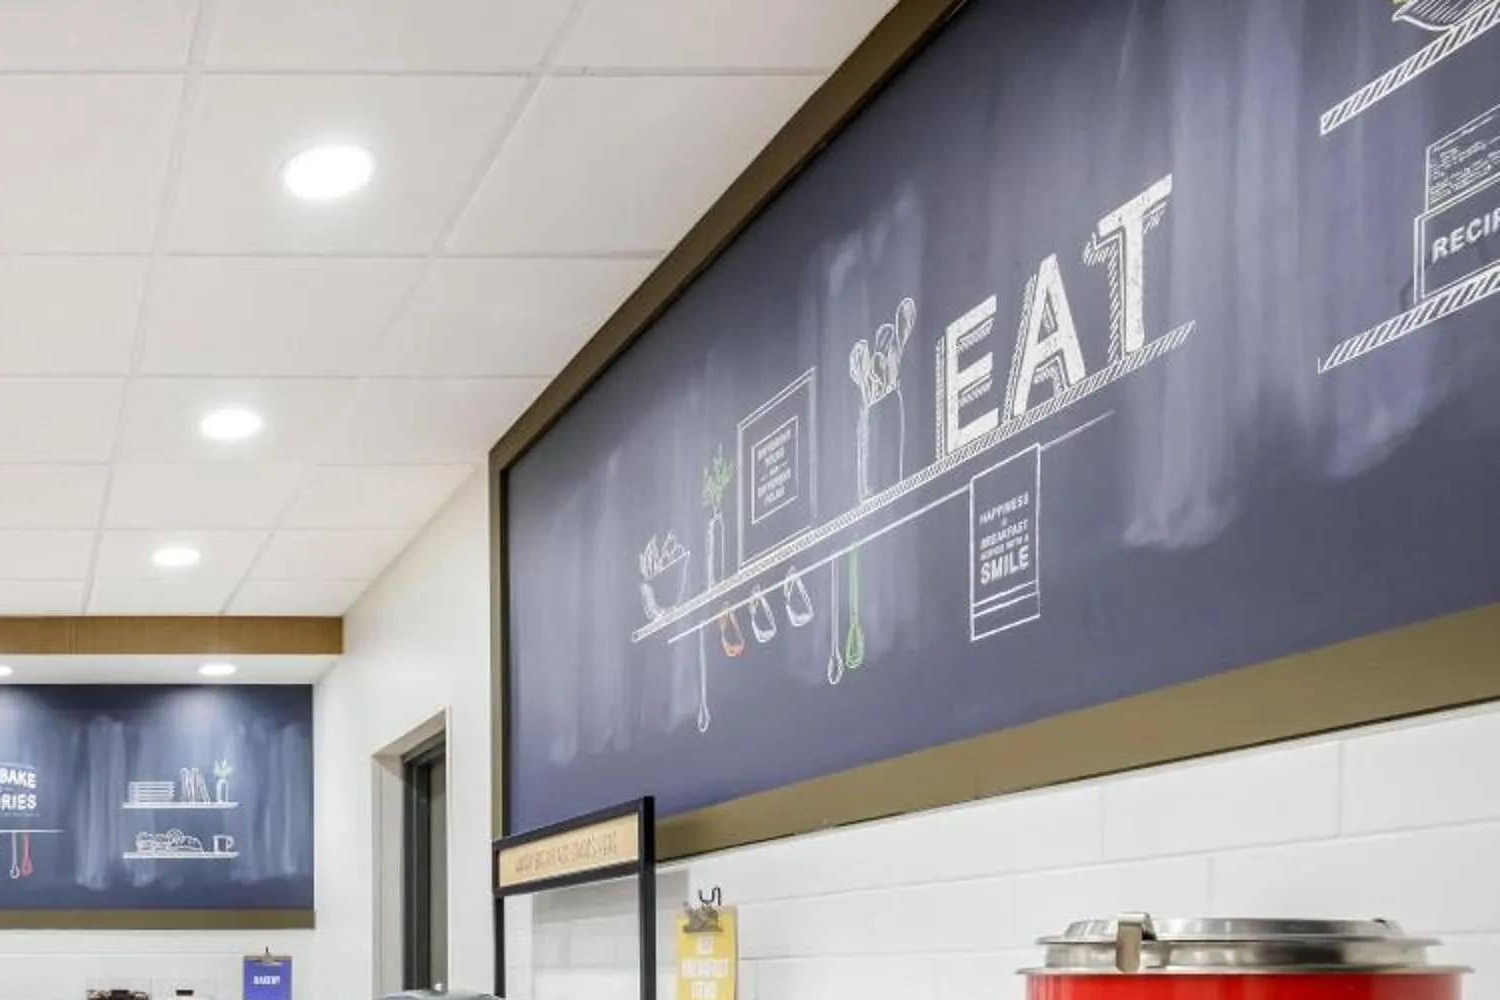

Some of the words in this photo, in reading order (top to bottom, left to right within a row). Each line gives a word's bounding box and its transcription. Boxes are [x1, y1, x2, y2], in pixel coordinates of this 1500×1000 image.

[938, 174, 1173, 457] EAT
[979, 491, 1029, 525] HAPPINESS
[980, 519, 1029, 550] BREAKFAST
[980, 546, 1029, 585] SMILE
[0, 767, 37, 789] BAKE
